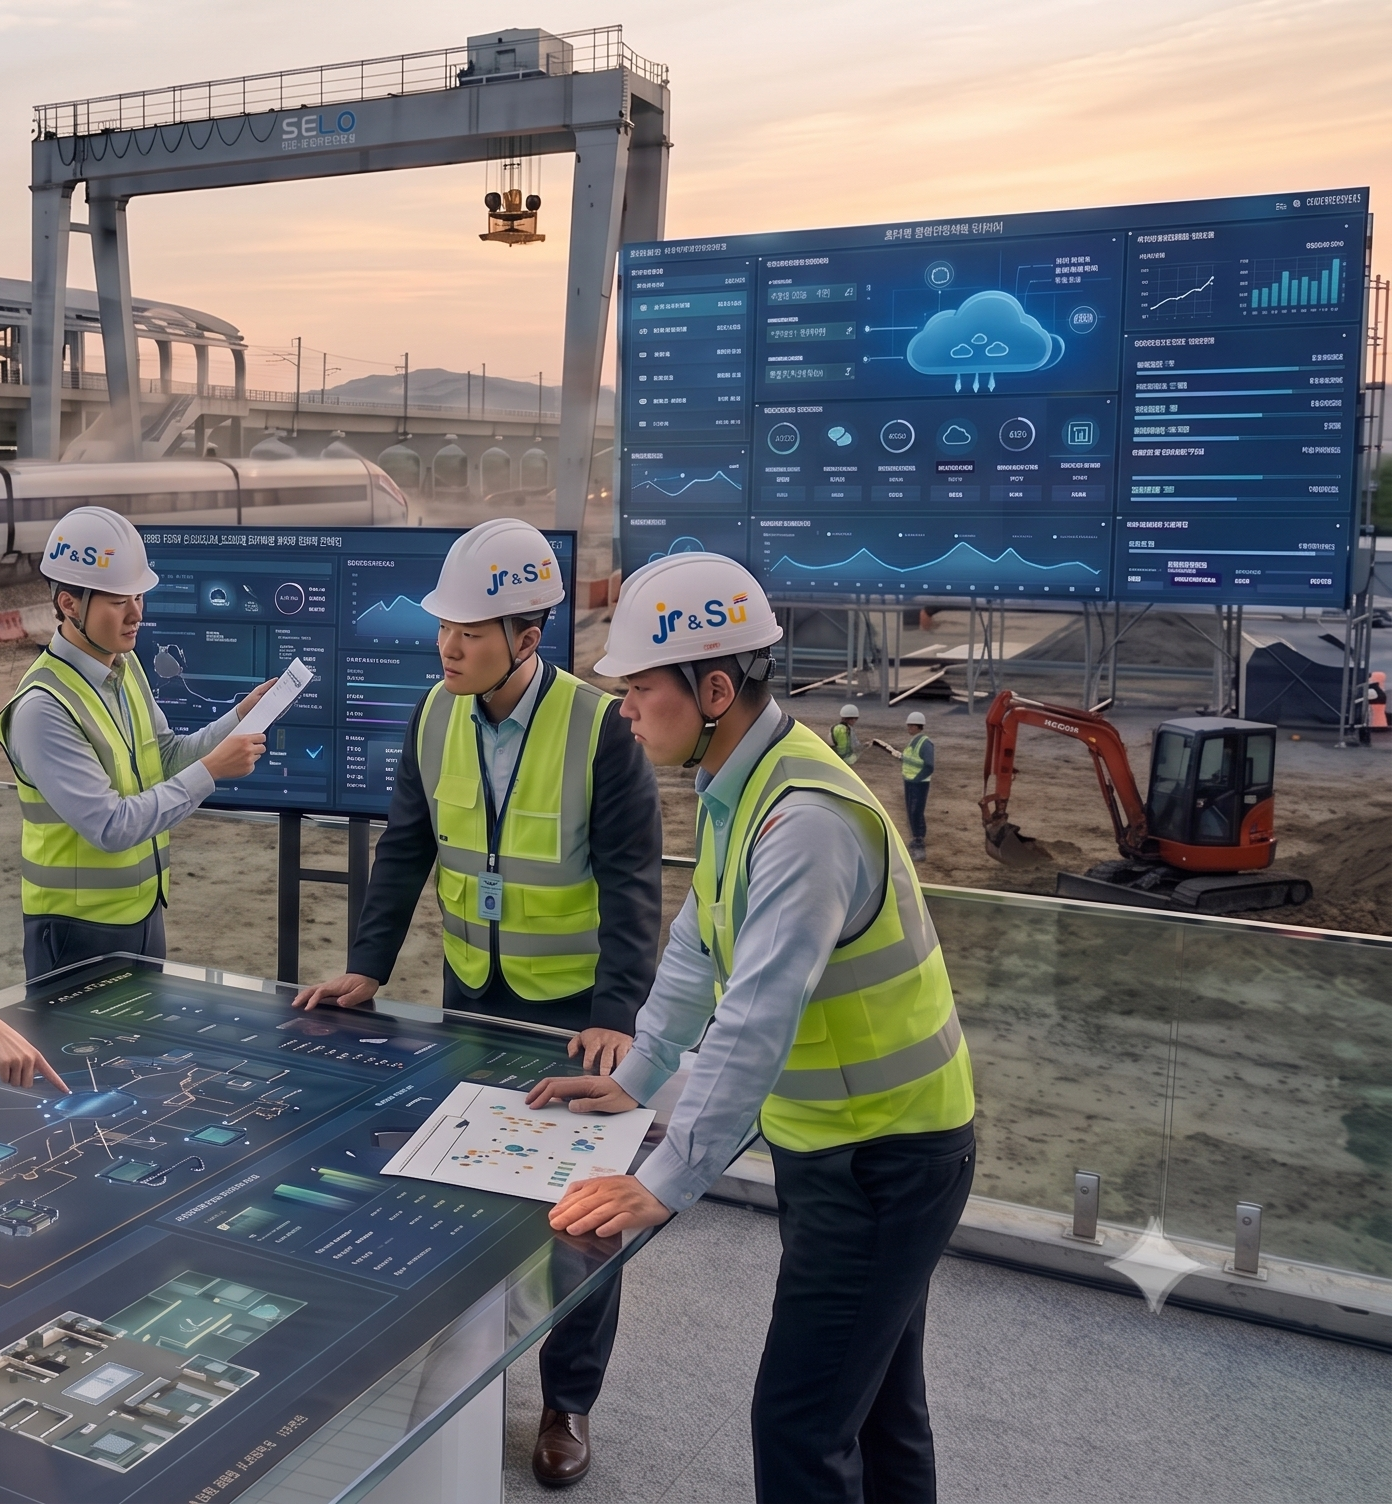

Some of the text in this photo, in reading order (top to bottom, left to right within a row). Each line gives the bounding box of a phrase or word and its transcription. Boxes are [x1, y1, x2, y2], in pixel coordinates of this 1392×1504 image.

[282, 110, 356, 139] SELO
[69, 550, 79, 562] &
[512, 573, 522, 585] &
[688, 614, 703, 630] &
